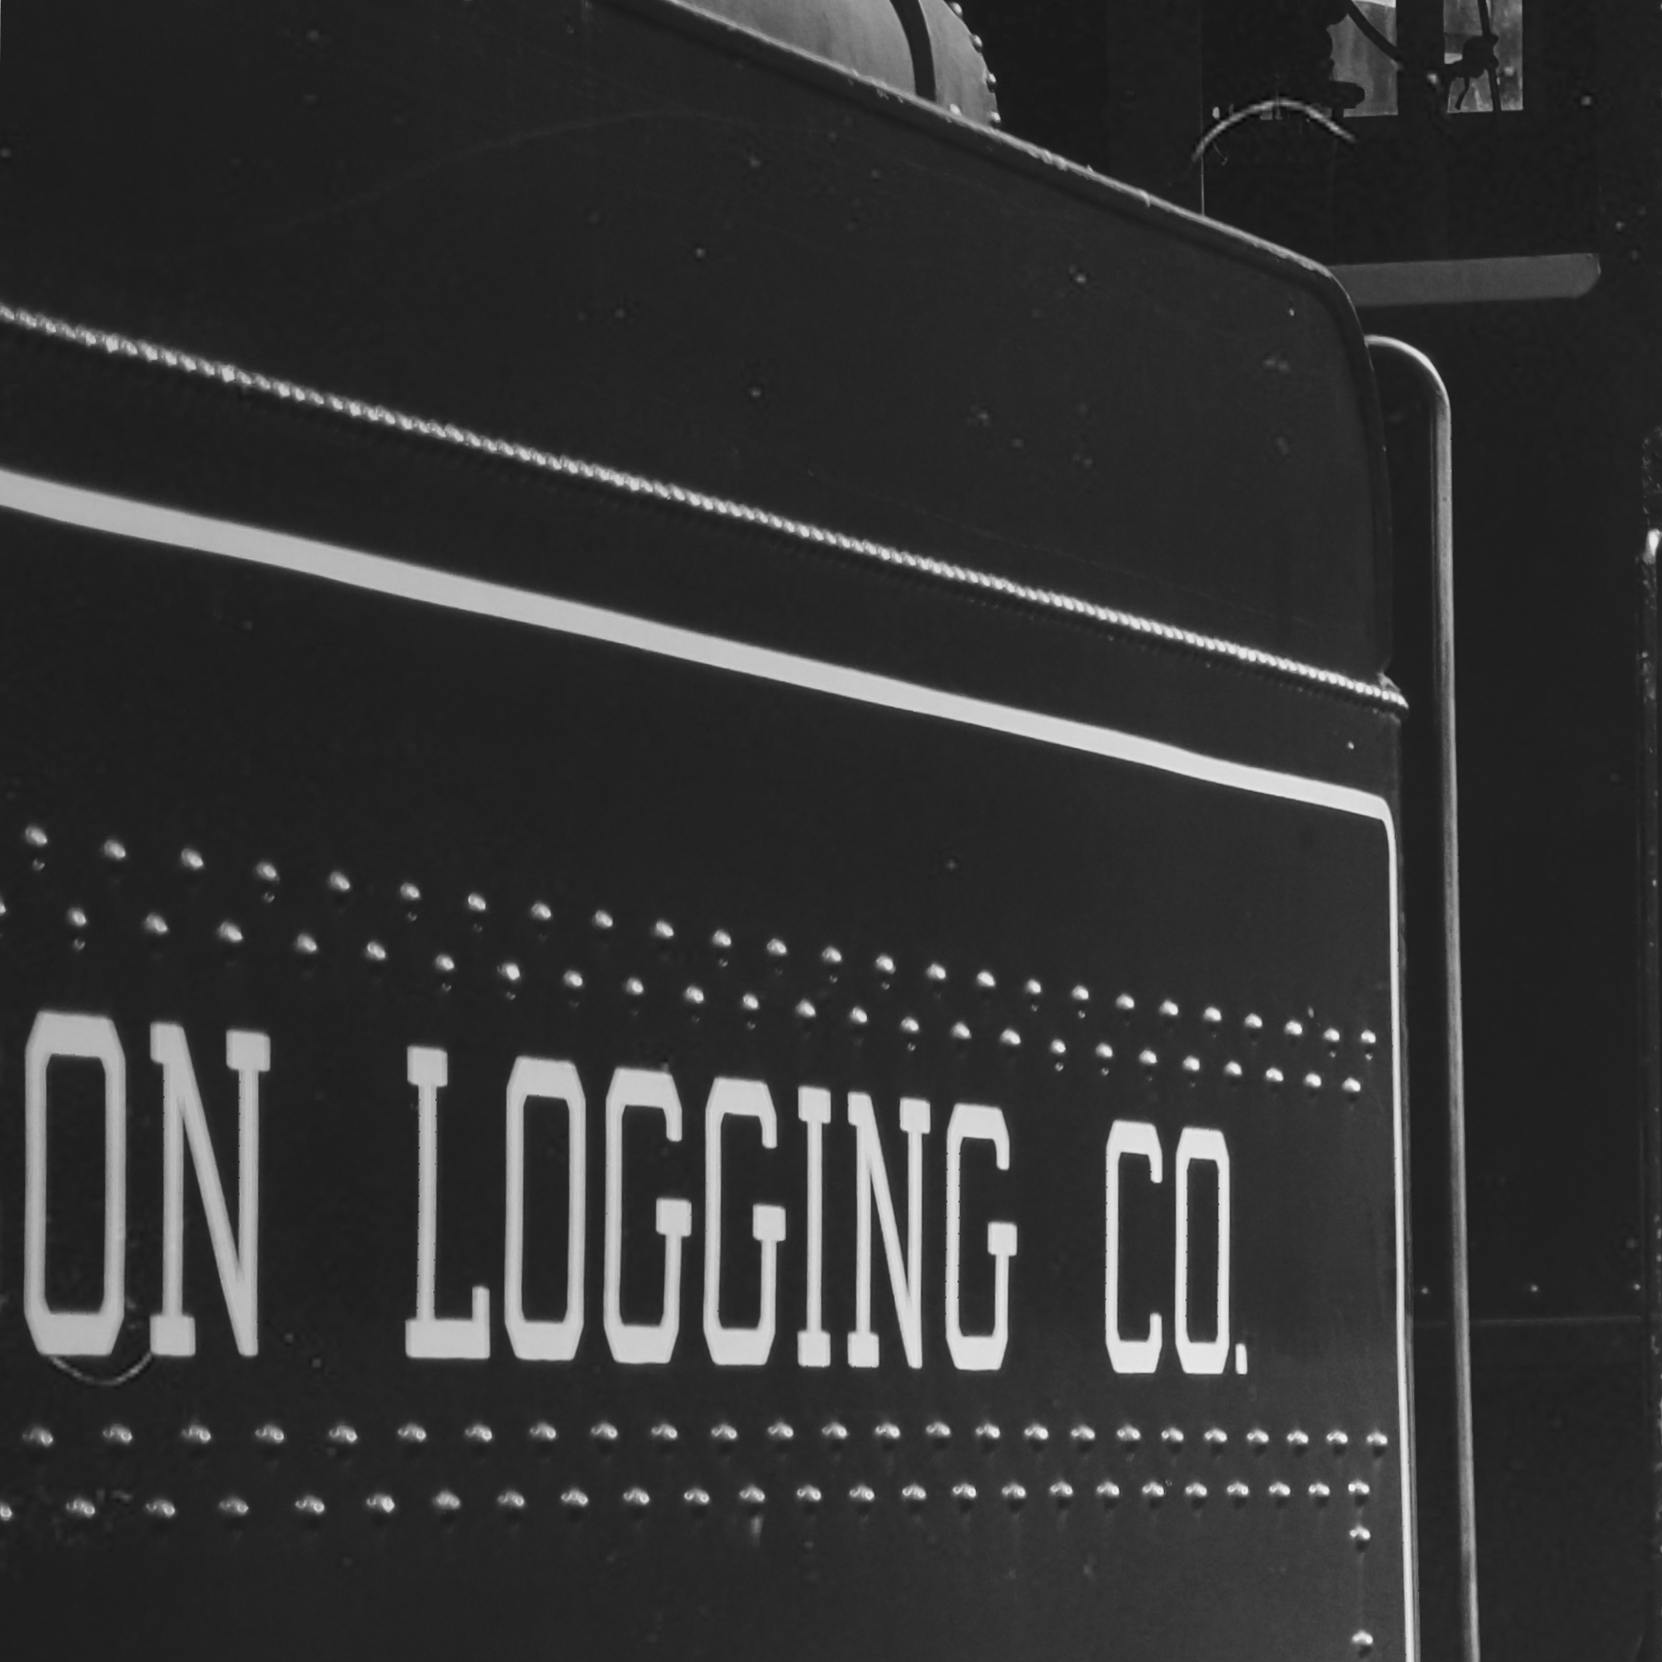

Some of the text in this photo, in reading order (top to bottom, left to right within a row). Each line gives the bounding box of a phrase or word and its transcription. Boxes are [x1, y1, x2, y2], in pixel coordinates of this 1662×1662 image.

[25, 1011, 1248, 1375] ON LOGGING CO.
